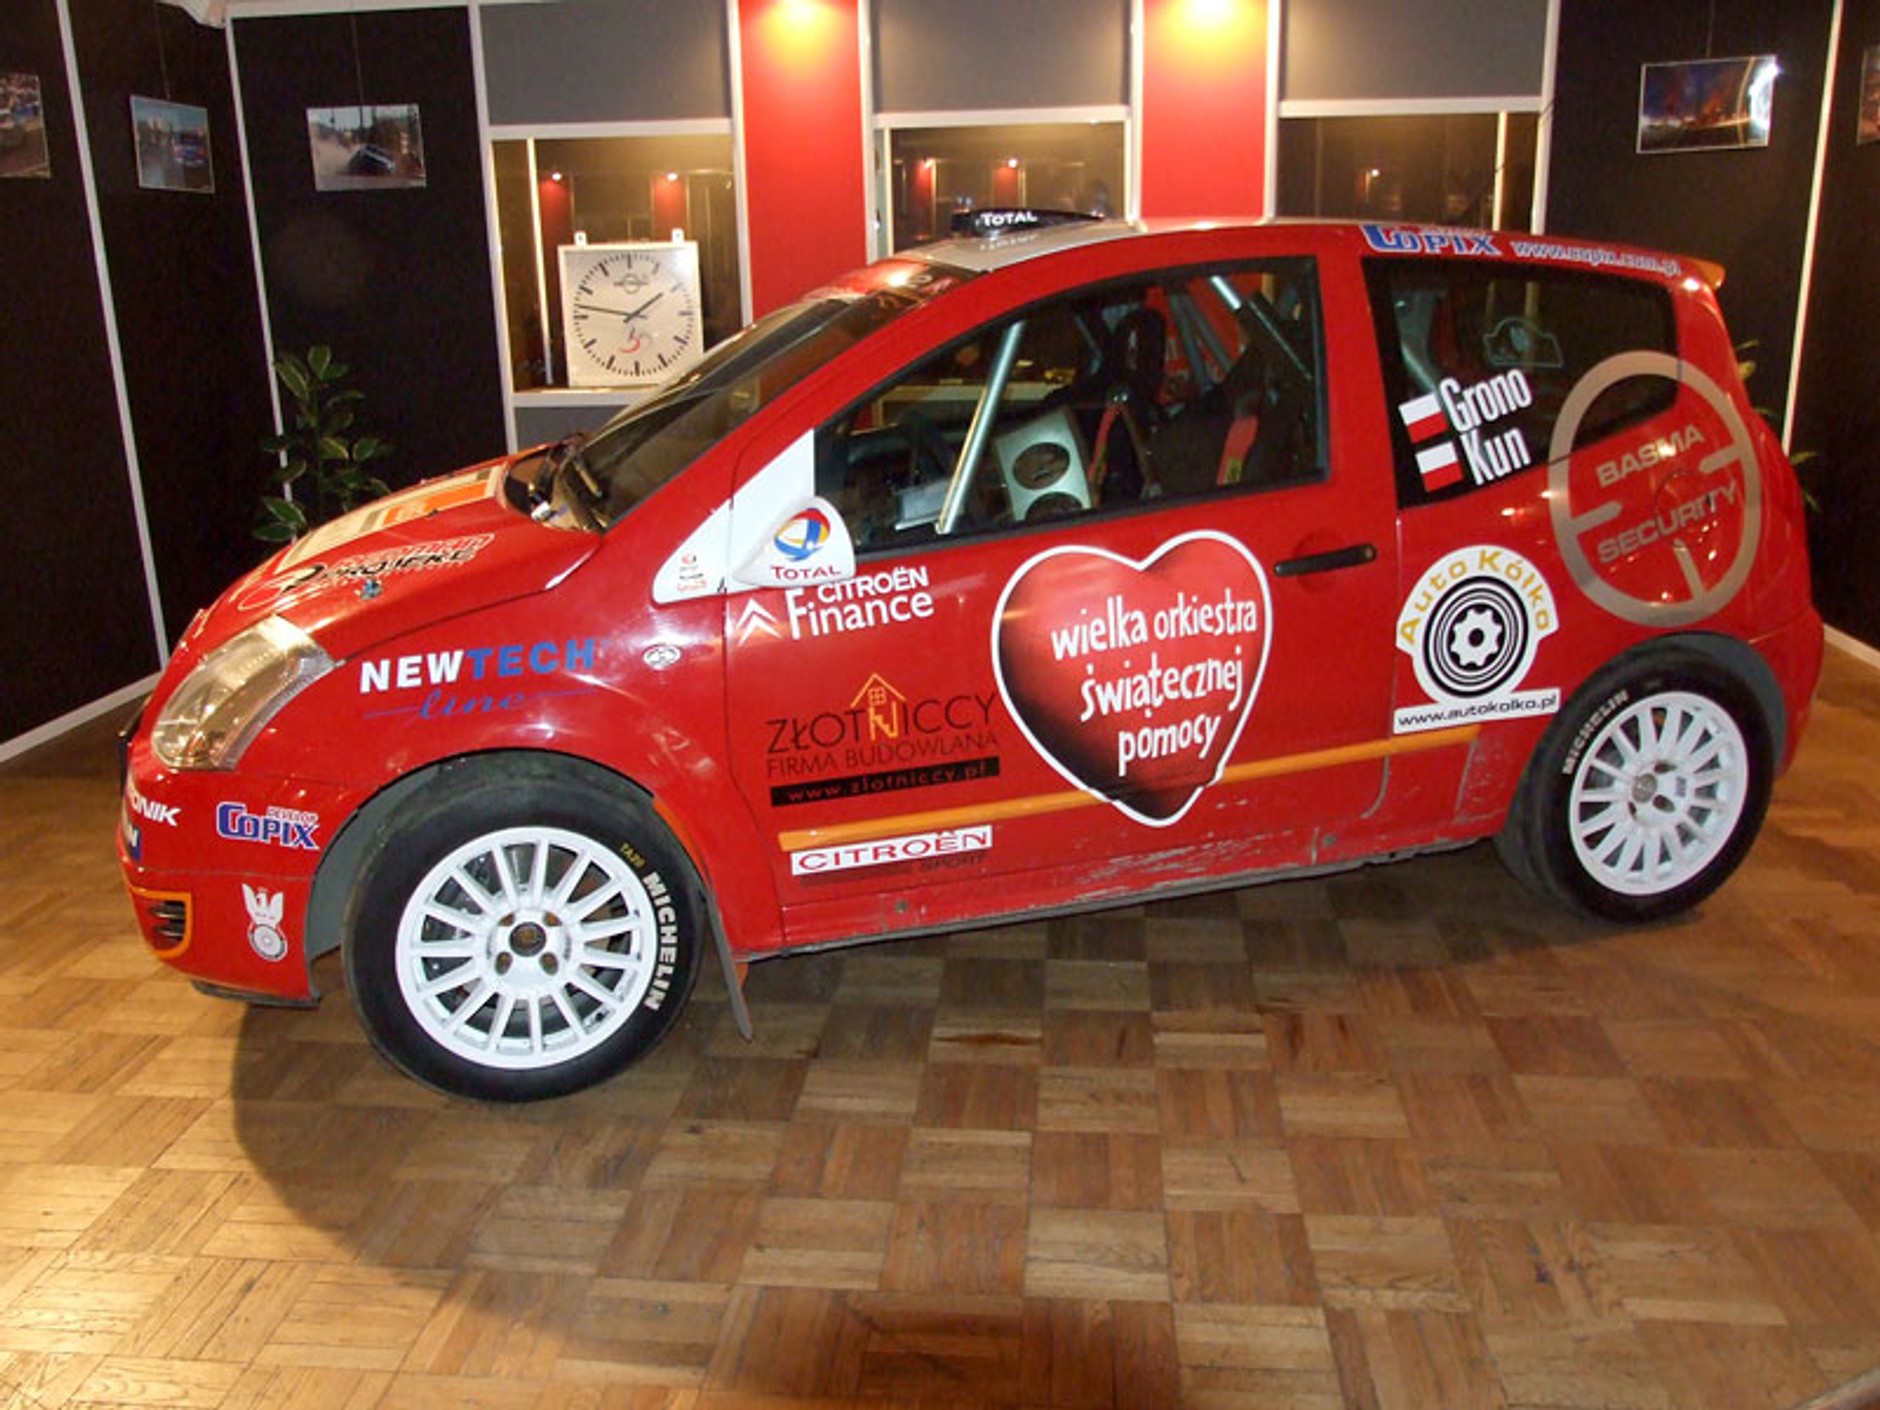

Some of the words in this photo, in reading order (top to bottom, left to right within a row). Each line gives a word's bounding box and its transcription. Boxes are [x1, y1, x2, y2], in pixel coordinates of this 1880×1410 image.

[979, 211, 1037, 226] TOTAL
[1439, 367, 1533, 433] Grono
[1459, 426, 1532, 485] Kun
[1596, 424, 1705, 487] BASMA
[1597, 480, 1738, 564] SECURITY
[771, 565, 841, 580] TOTAL
[817, 566, 930, 603] CITROËN
[1400, 559, 1468, 644] Auto
[1478, 549, 1550, 631] Kółko
[785, 587, 934, 640] Finance
[1051, 594, 1148, 660] wielka
[1153, 587, 1257, 640] orkiestra
[359, 638, 597, 693] NEWTECH
[1079, 645, 1243, 723] świątecznej
[764, 692, 997, 754] ZŁOTNICCY
[1118, 714, 1222, 777] pomocy
[1561, 688, 1628, 775] MICHELIN
[766, 753, 837, 779] FIRMA
[845, 732, 998, 769] BUDOWLANA
[216, 801, 320, 851] COPIX
[799, 829, 988, 871] CITROËN
[642, 870, 678, 1011] MICHELIN
